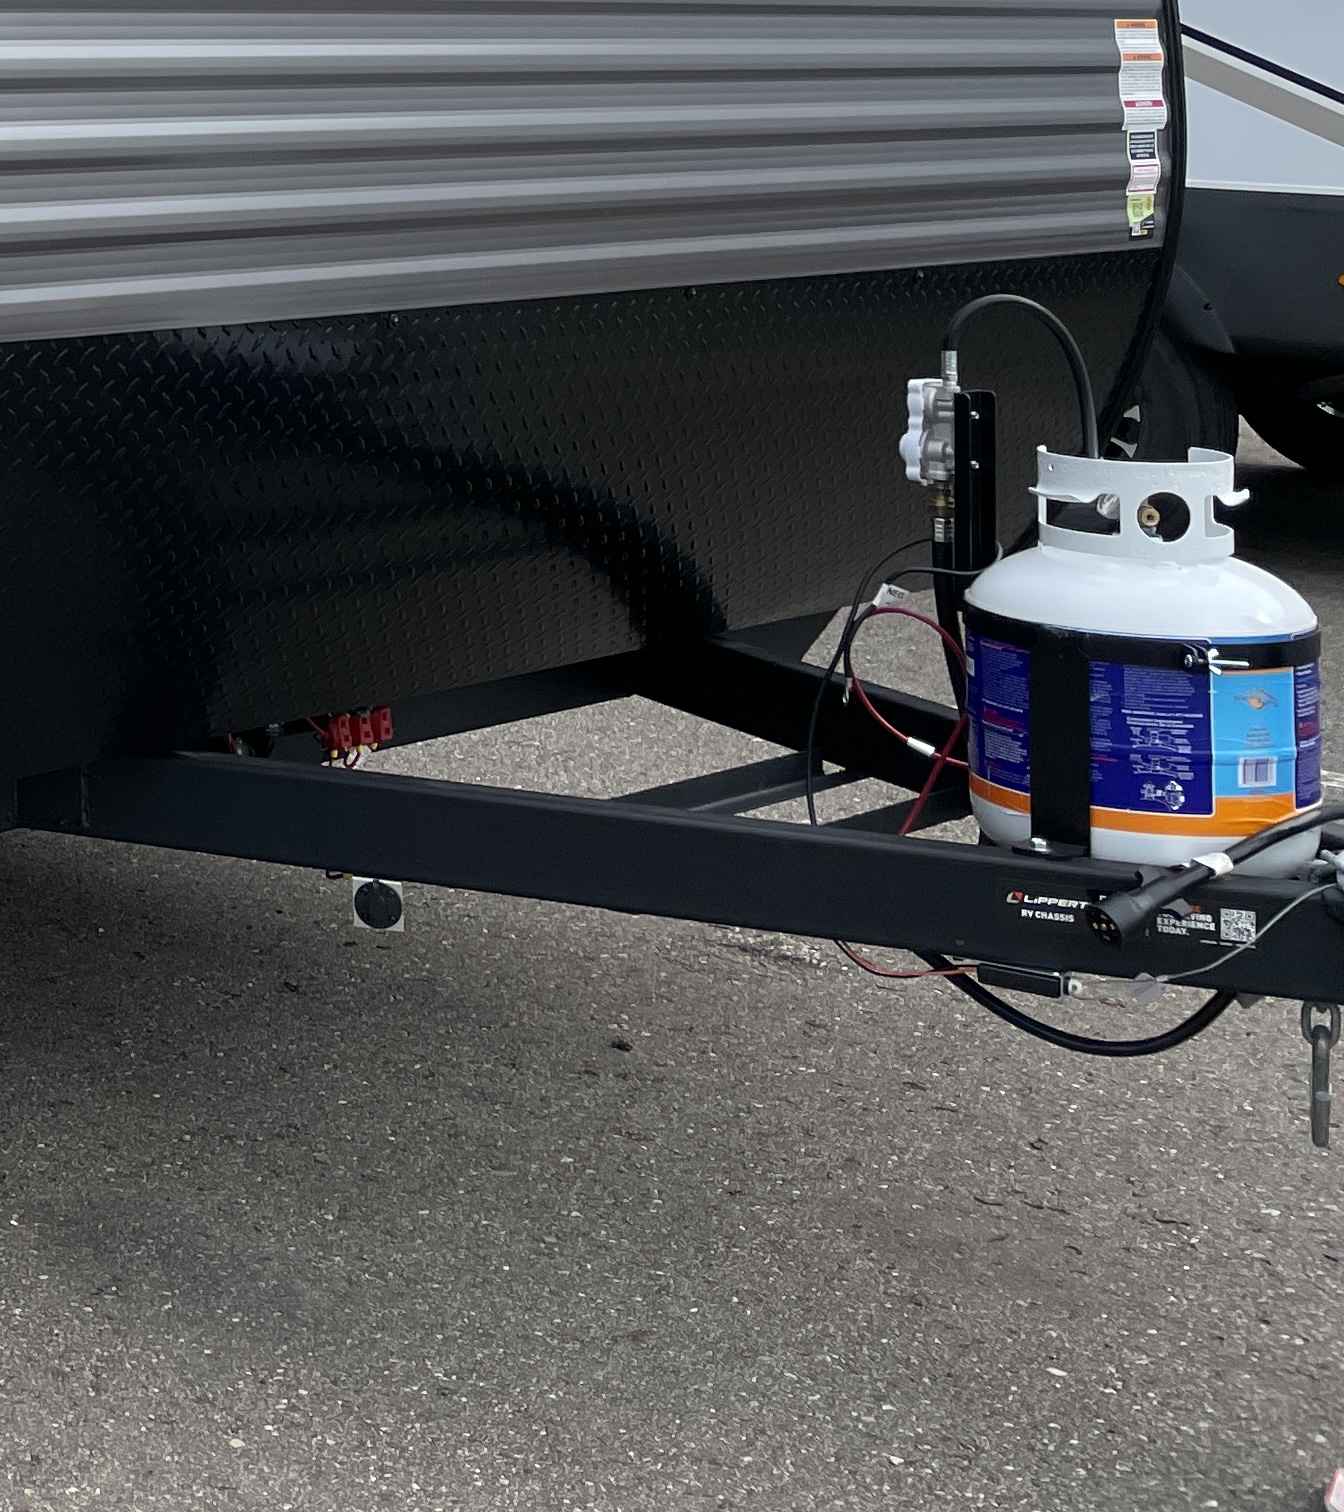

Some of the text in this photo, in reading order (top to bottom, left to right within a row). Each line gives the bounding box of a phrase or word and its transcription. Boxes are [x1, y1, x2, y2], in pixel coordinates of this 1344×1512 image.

[1021, 909, 1075, 923] RV CHASSIS
[1156, 916, 1216, 932] EXPERIENCE
[1158, 926, 1190, 936] TODAY.
